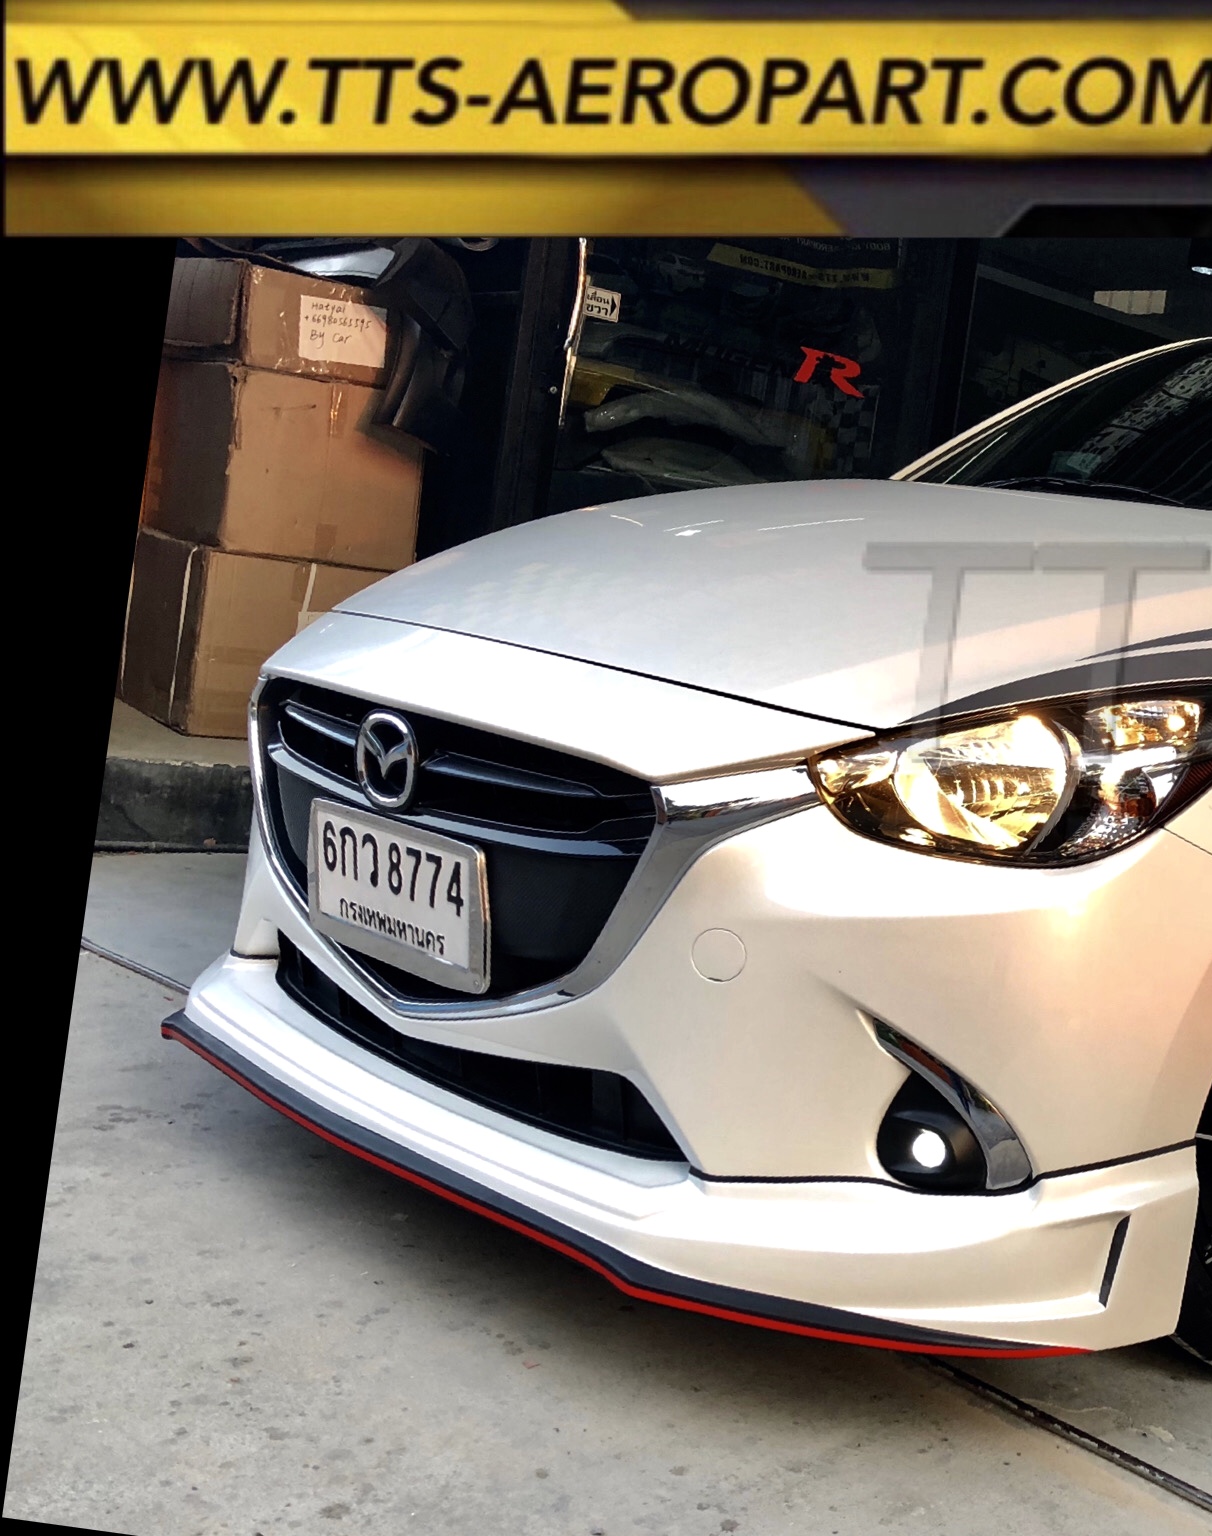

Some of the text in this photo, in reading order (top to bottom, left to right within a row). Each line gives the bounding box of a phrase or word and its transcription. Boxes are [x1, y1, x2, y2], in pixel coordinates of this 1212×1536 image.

[310, 329, 325, 349] By
[322, 820, 465, 918] 6กว 8774
[339, 897, 445, 956] กรงเทพมหานคร
